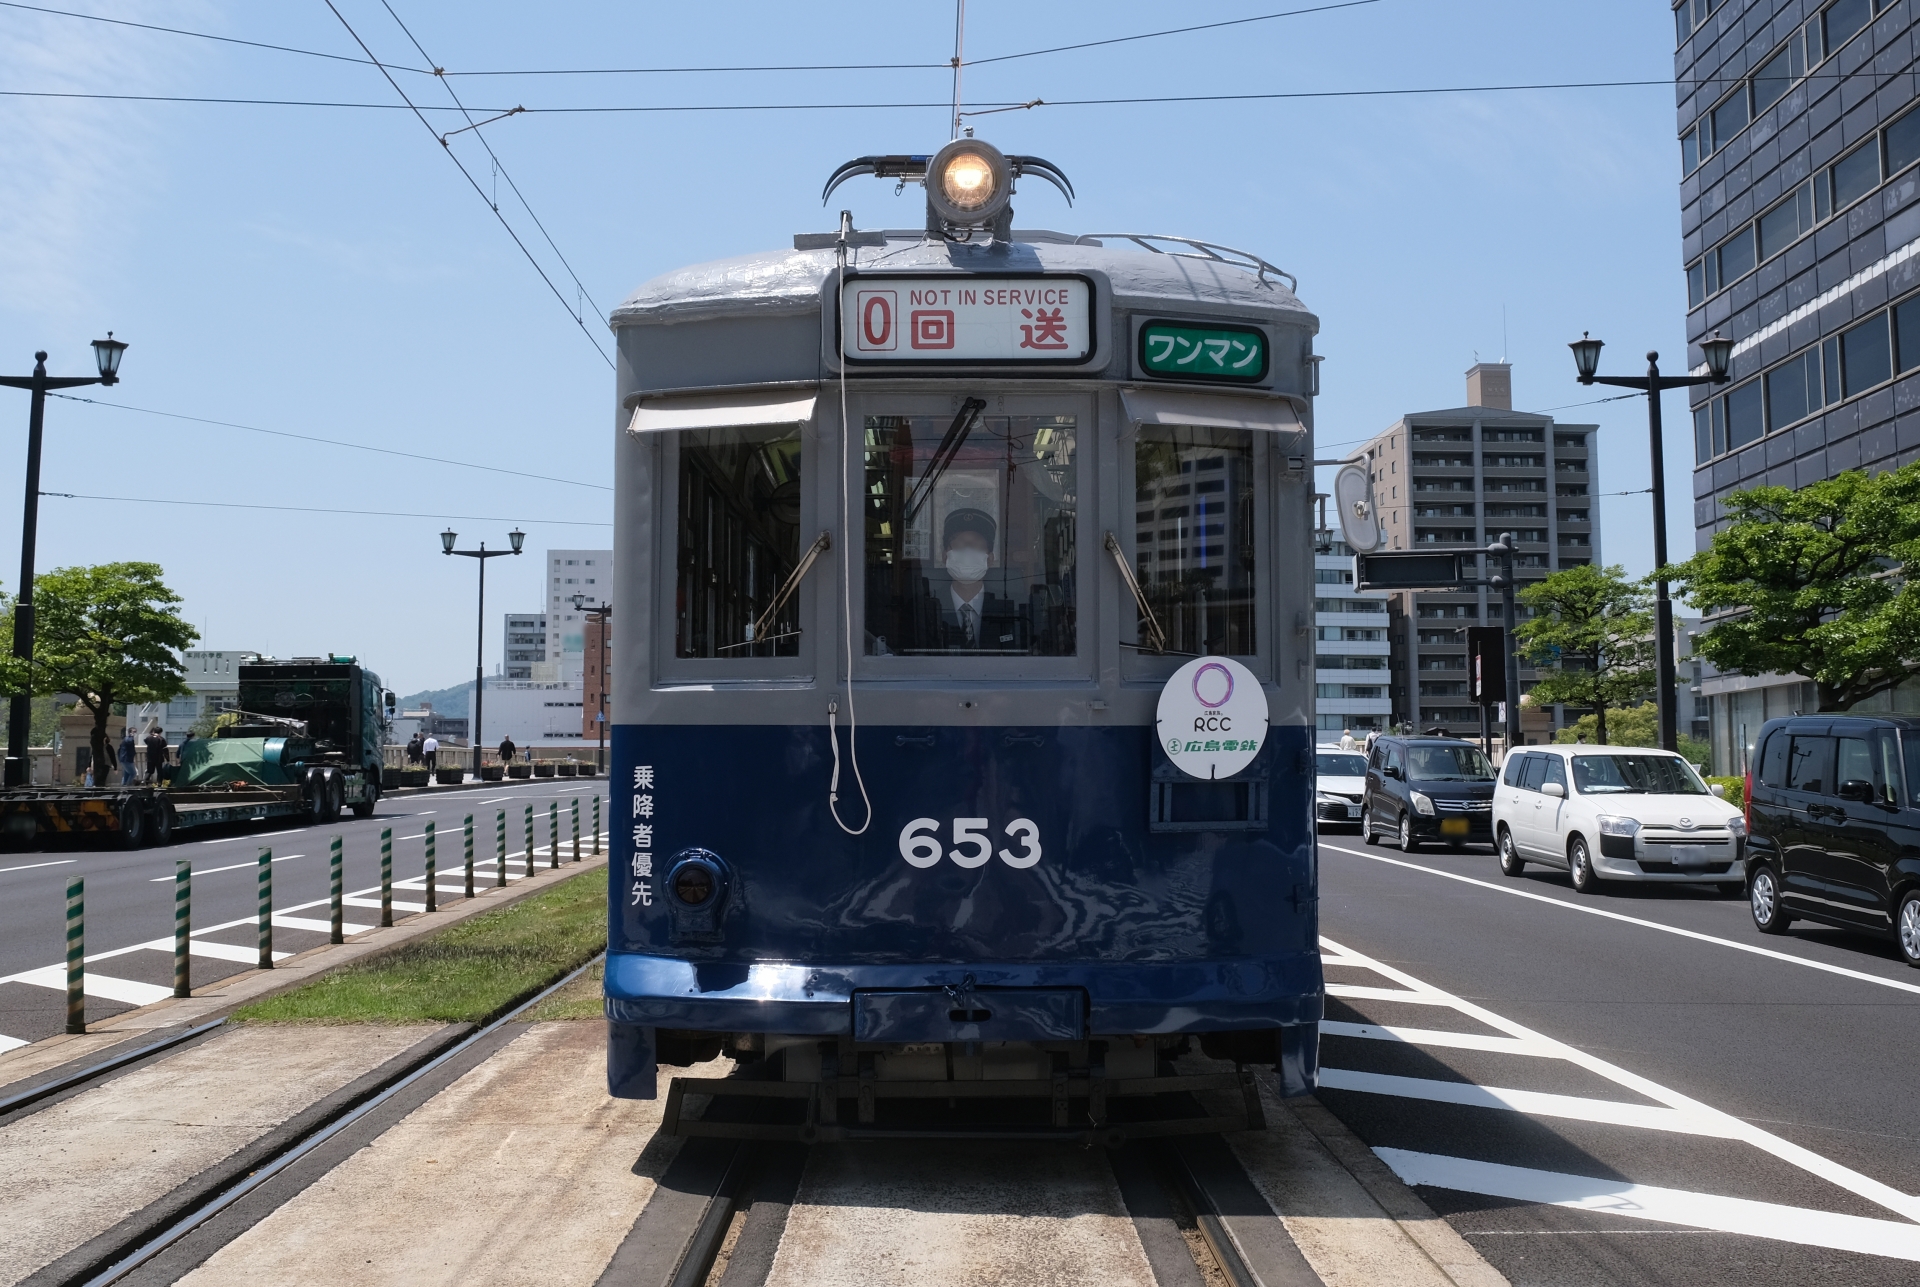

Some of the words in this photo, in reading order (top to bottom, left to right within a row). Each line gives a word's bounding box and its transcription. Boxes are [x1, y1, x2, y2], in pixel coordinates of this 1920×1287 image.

[910, 289, 951, 306] NOT
[958, 289, 977, 306] IN
[983, 289, 1069, 305] SERVICE
[863, 296, 892, 346] 0
[1148, 334, 1258, 369] ワンマン
[1194, 716, 1232, 732] RCC
[1184, 739, 1258, 752] 広島電鉄
[631, 765, 654, 906] 乗降者優先
[898, 817, 1042, 869] 653
